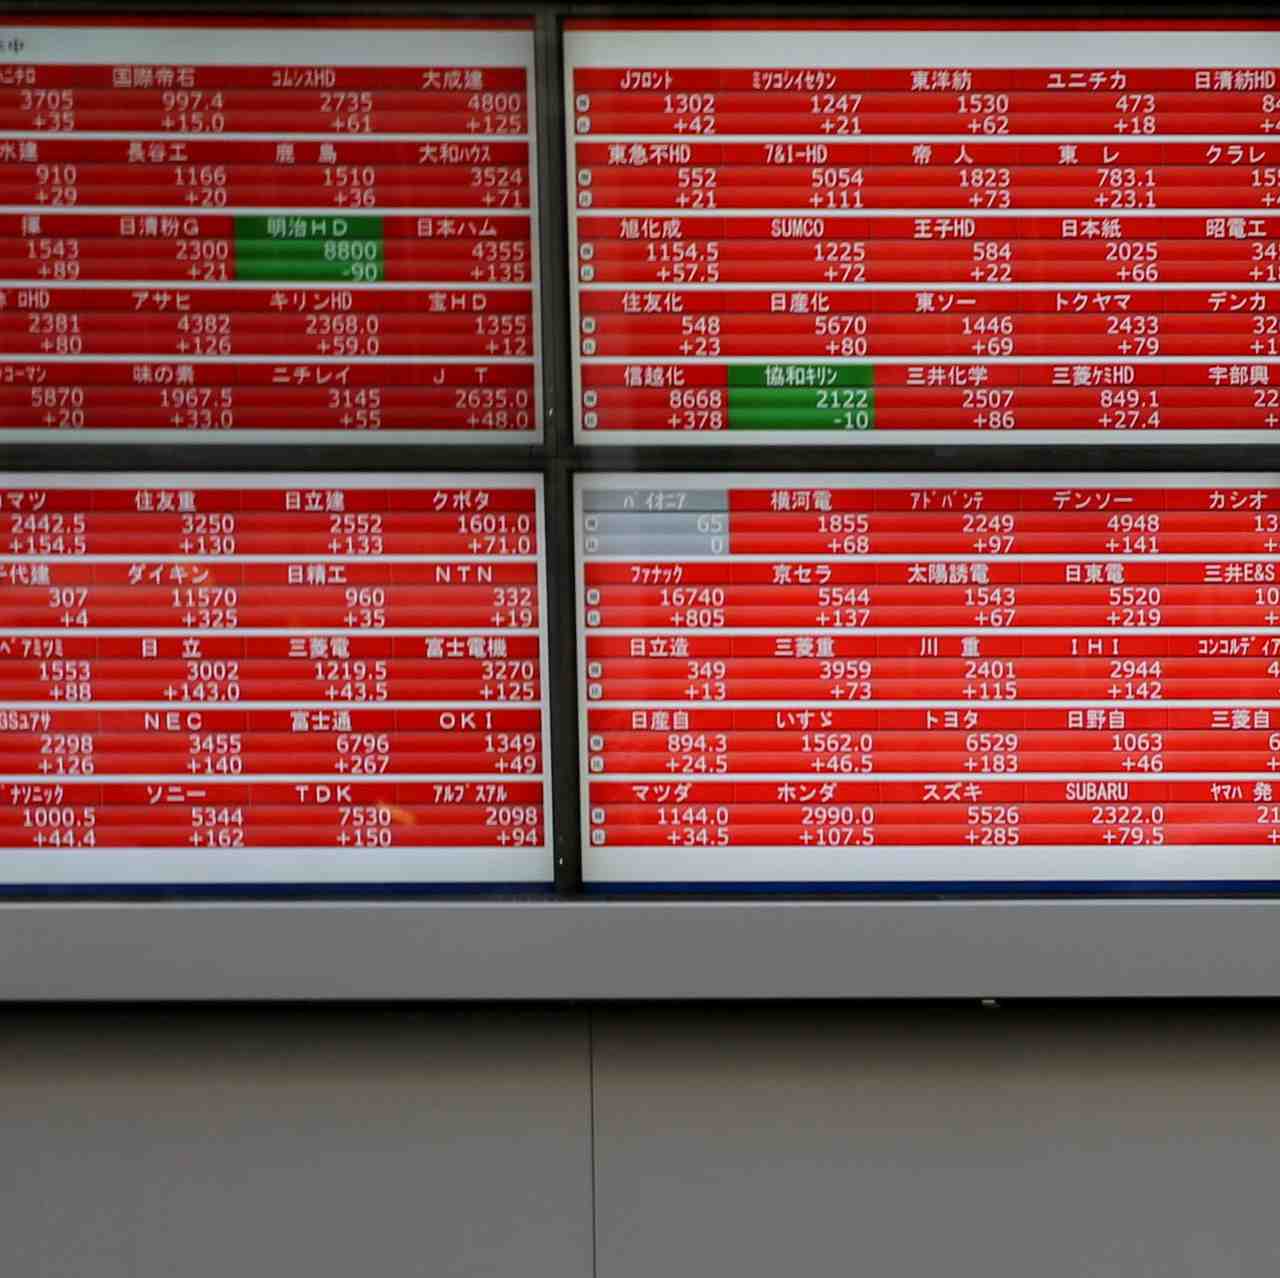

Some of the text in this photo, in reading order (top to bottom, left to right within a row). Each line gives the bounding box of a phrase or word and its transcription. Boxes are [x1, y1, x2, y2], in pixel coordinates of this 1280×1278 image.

[1047, 71, 1126, 89] ユニチカ
[163, 91, 223, 111] 997.4
[1116, 95, 1155, 112] 473
[162, 112, 224, 131] +15.0
[1114, 111, 1155, 134] +18
[1207, 145, 1265, 164] クラレ
[175, 166, 226, 186] 1166
[185, 185, 227, 205] +20
[418, 218, 496, 237] 日本ハム
[772, 219, 824, 237] SUMCO
[1207, 218, 1266, 238] 昭電工
[324, 241, 376, 260] 8800
[472, 241, 524, 260] 4355
[815, 242, 864, 261] 1225
[342, 259, 377, 281] -90
[470, 259, 524, 281] +135
[824, 260, 865, 282] +72
[133, 291, 190, 310] アサヒ
[622, 293, 683, 312] 住友化
[178, 314, 230, 334] 4382
[682, 316, 720, 335] 548
[176, 335, 231, 354] +126
[680, 334, 720, 356] +23
[273, 367, 349, 384] ニチレイ
[907, 366, 987, 386] 三井化学
[329, 389, 380, 408] 3145
[963, 390, 1013, 408] 2507
[340, 407, 380, 428] +55
[974, 411, 1014, 429] +86
[1053, 491, 1133, 509] デンソー
[331, 514, 382, 533] 2552
[1107, 515, 1159, 532] 4948
[328, 532, 383, 554] +133
[1106, 536, 1159, 553] +141
[129, 564, 208, 584] ダイキン
[773, 564, 831, 584] 京セラ
[173, 588, 236, 607] 11570
[819, 588, 870, 606] 5544
[182, 606, 237, 627] +325
[816, 609, 870, 627] +137
[425, 637, 507, 658] 富士電機
[775, 637, 834, 657] 三菱重
[482, 661, 533, 680] 3270
[820, 661, 871, 679] 3959
[480, 679, 534, 700] +125
[831, 682, 871, 700] +73
[290, 711, 351, 731] 富士通
[927, 710, 977, 728] トヨタ
[337, 735, 389, 753] 6796
[966, 734, 1017, 752] 6529
[335, 752, 389, 774] +267
[964, 751, 1017, 772] +183
[147, 786, 206, 804] ソニー
[1066, 783, 1128, 800] SUBARU
[192, 807, 243, 826] 5344
[1093, 807, 1163, 824] 2322.0
[190, 829, 244, 847] +162
[1103, 827, 1164, 845] +79.5
